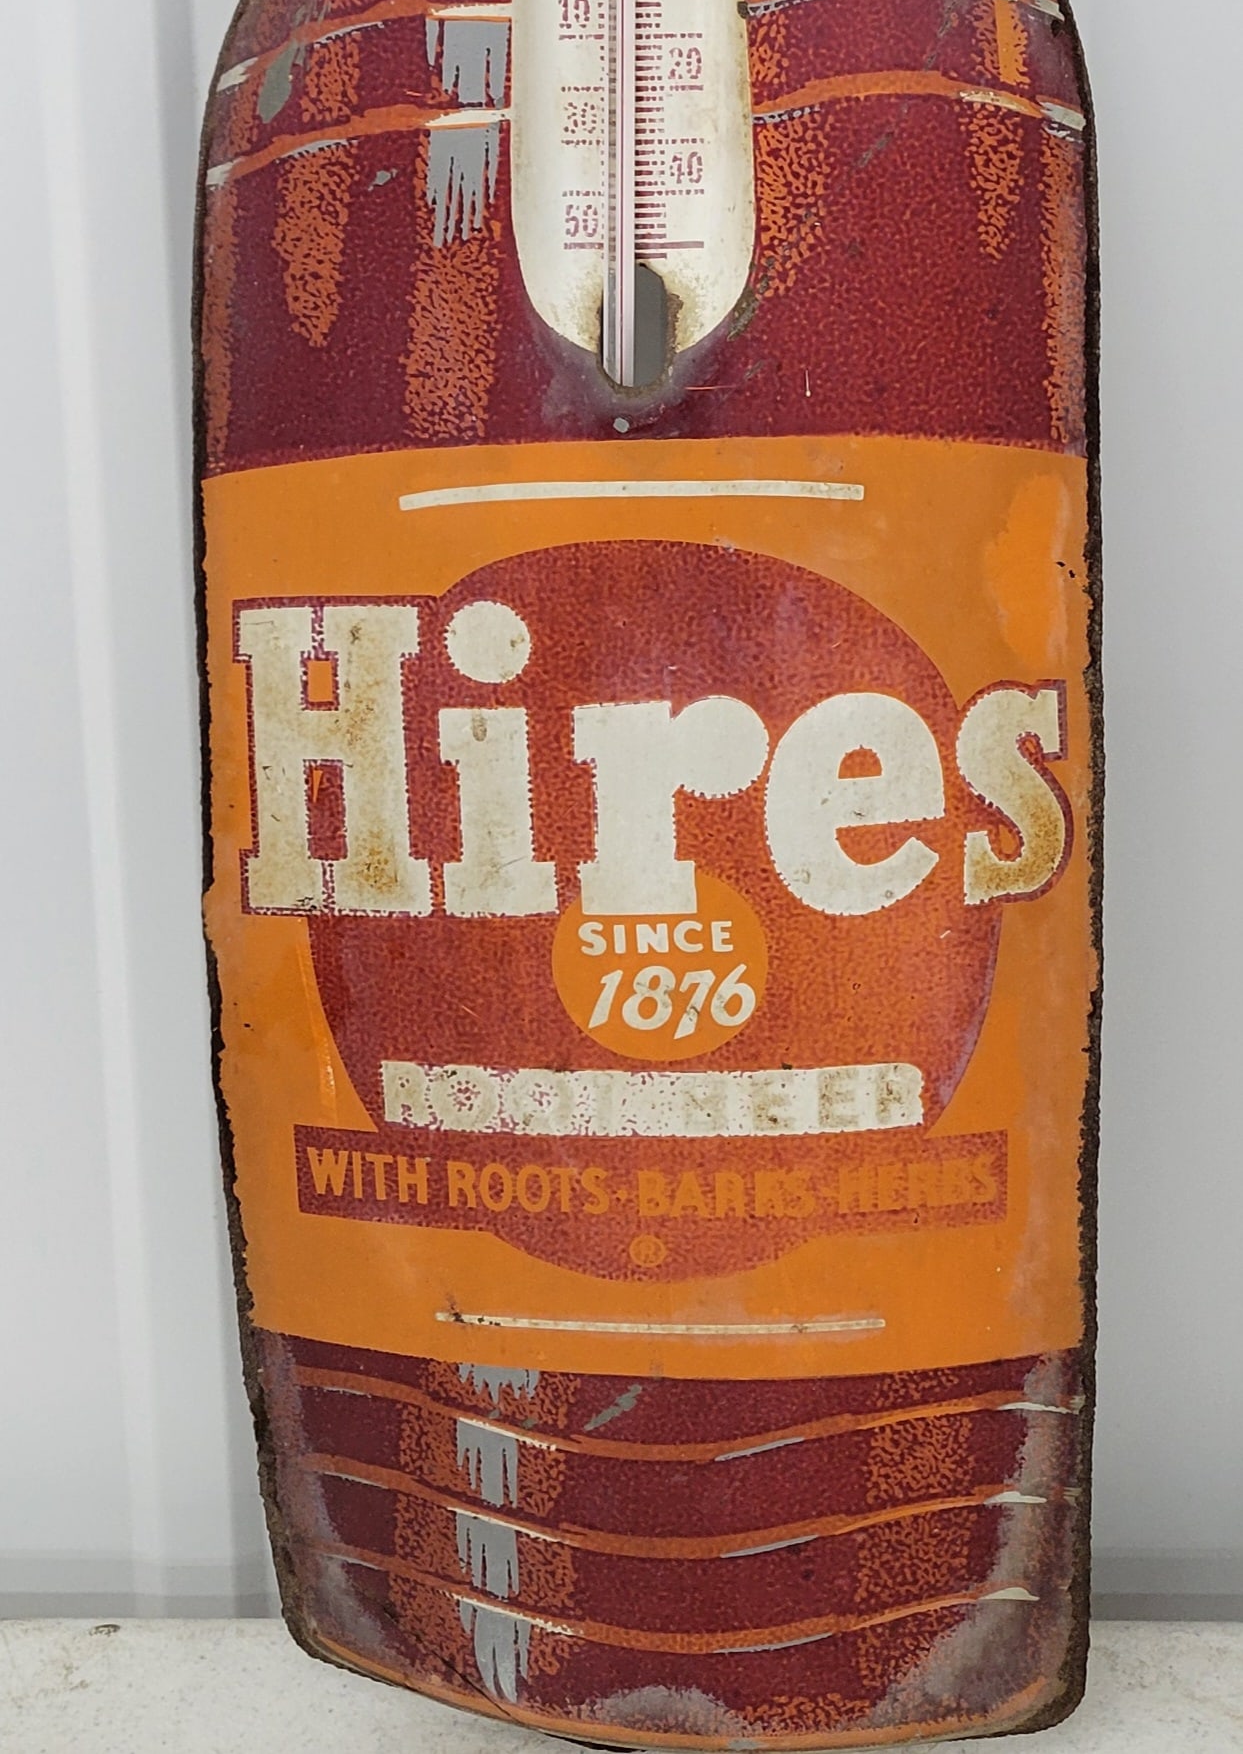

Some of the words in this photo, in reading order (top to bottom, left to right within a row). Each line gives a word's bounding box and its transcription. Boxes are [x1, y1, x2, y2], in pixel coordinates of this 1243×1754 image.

[668, 47, 702, 80] 20
[670, 151, 703, 184] 40
[564, 204, 599, 238] 50
[236, 598, 1070, 918] Hires
[578, 920, 734, 955] SINCE
[587, 962, 757, 1040] 1876
[307, 1146, 429, 1205] WITH
